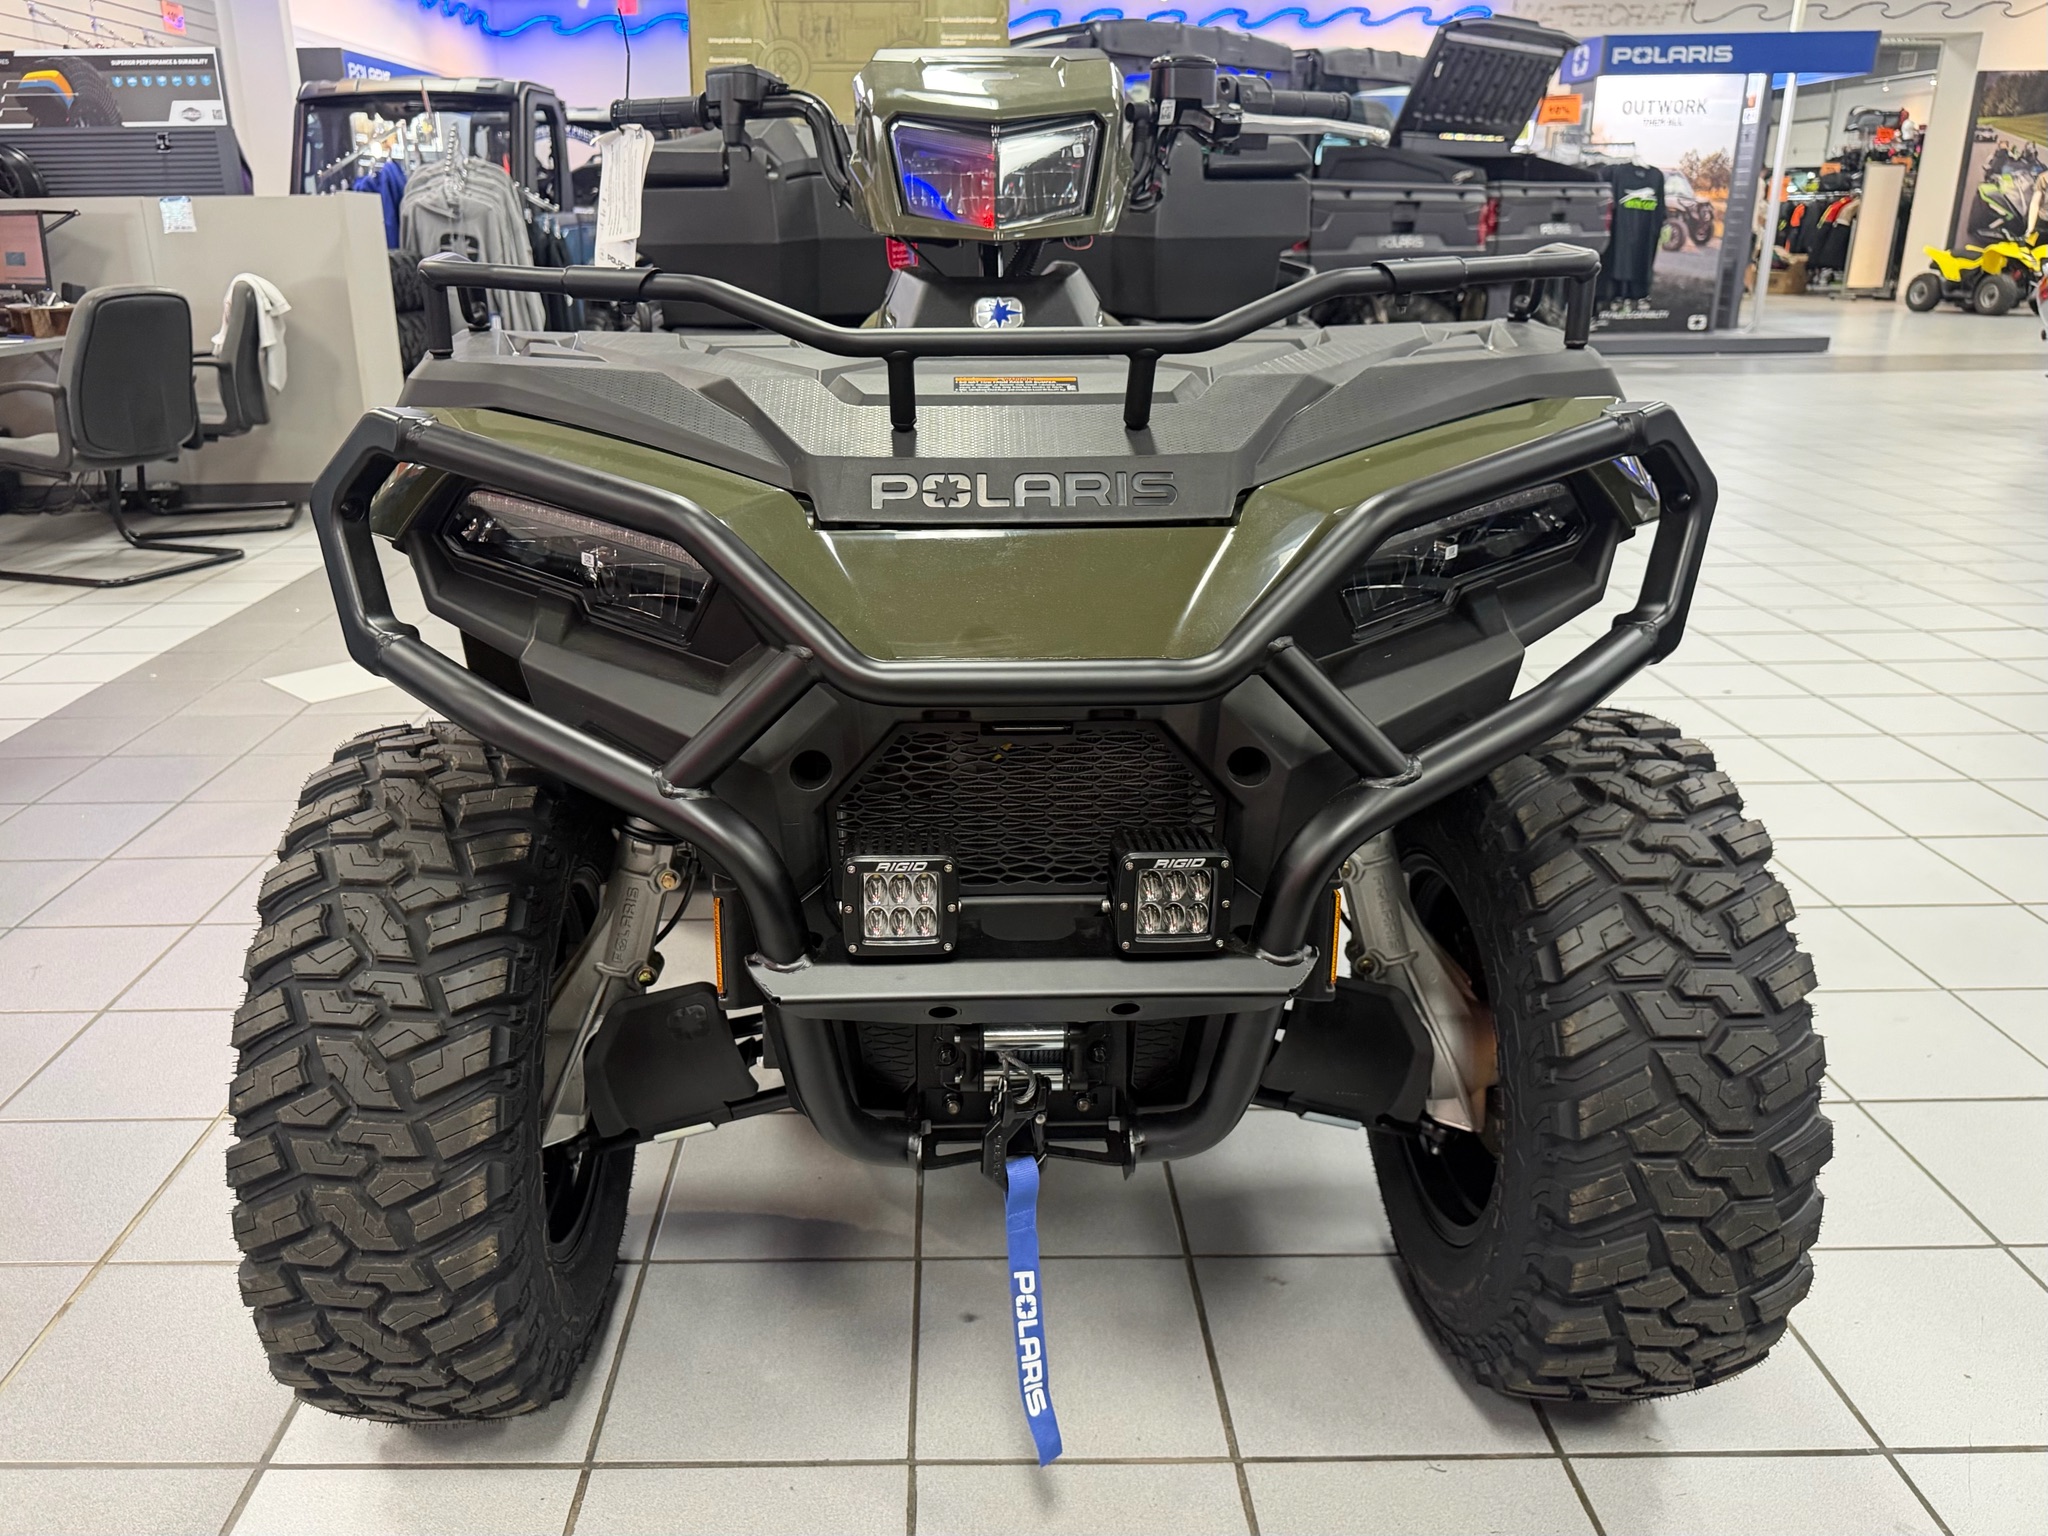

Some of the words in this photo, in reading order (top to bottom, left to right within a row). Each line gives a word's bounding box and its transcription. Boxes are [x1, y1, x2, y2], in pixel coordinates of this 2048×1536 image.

[178, 58, 209, 66] DURABILITY
[1611, 45, 1734, 65] POLARIS
[1622, 98, 1708, 115] OUTWORK
[1377, 234, 1425, 249] POLARIS
[870, 471, 1178, 510] POLARIS
[876, 861, 928, 872] RIGID
[1153, 857, 1207, 869] RIGID
[612, 887, 640, 964] POLARIS
[1013, 1270, 1047, 1417] POLARIS
